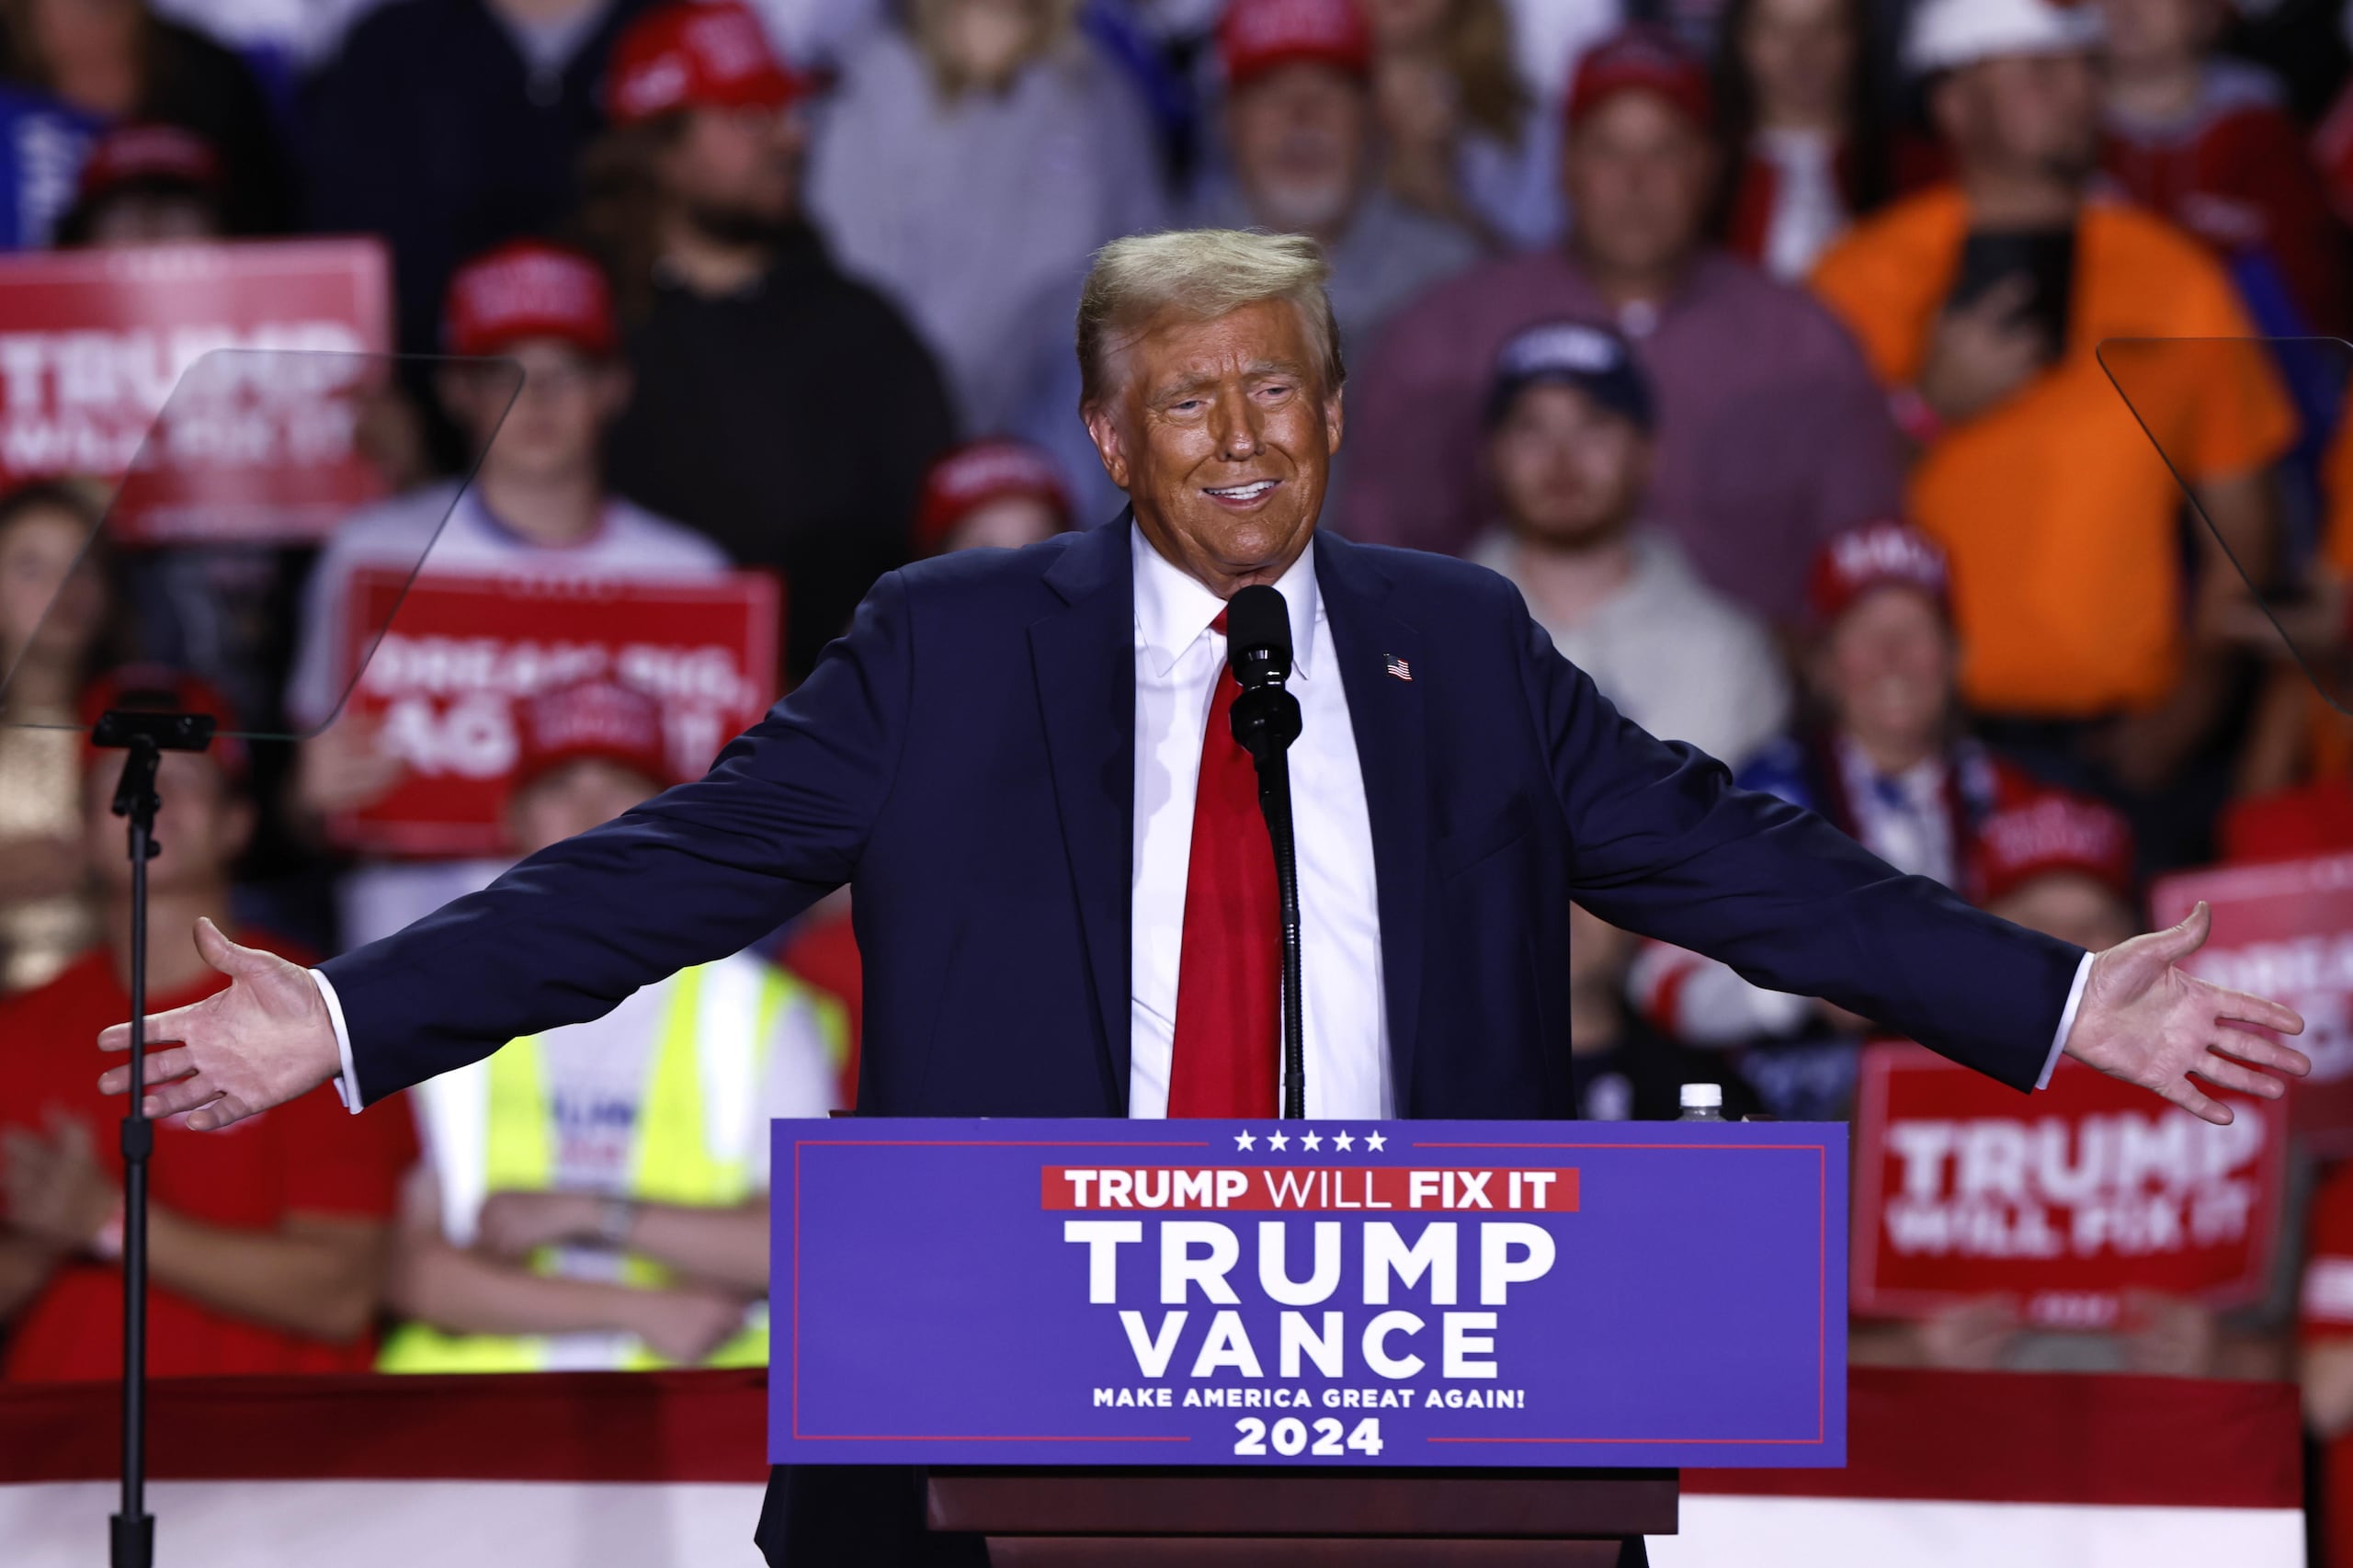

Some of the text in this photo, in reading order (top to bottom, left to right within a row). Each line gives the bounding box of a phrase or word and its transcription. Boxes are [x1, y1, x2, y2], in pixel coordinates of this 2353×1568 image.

[1886, 1101, 2261, 1206] TRUMP
[1064, 1169, 1557, 1209] TRUMP WILL FIX IT
[1063, 1220, 1556, 1306] TRUMP
[1119, 1310, 1498, 1380] VANCE
[1093, 1388, 1525, 1409] MAKE AMERICA GREAT AGAIN!
[1233, 1416, 1383, 1457] 2024
